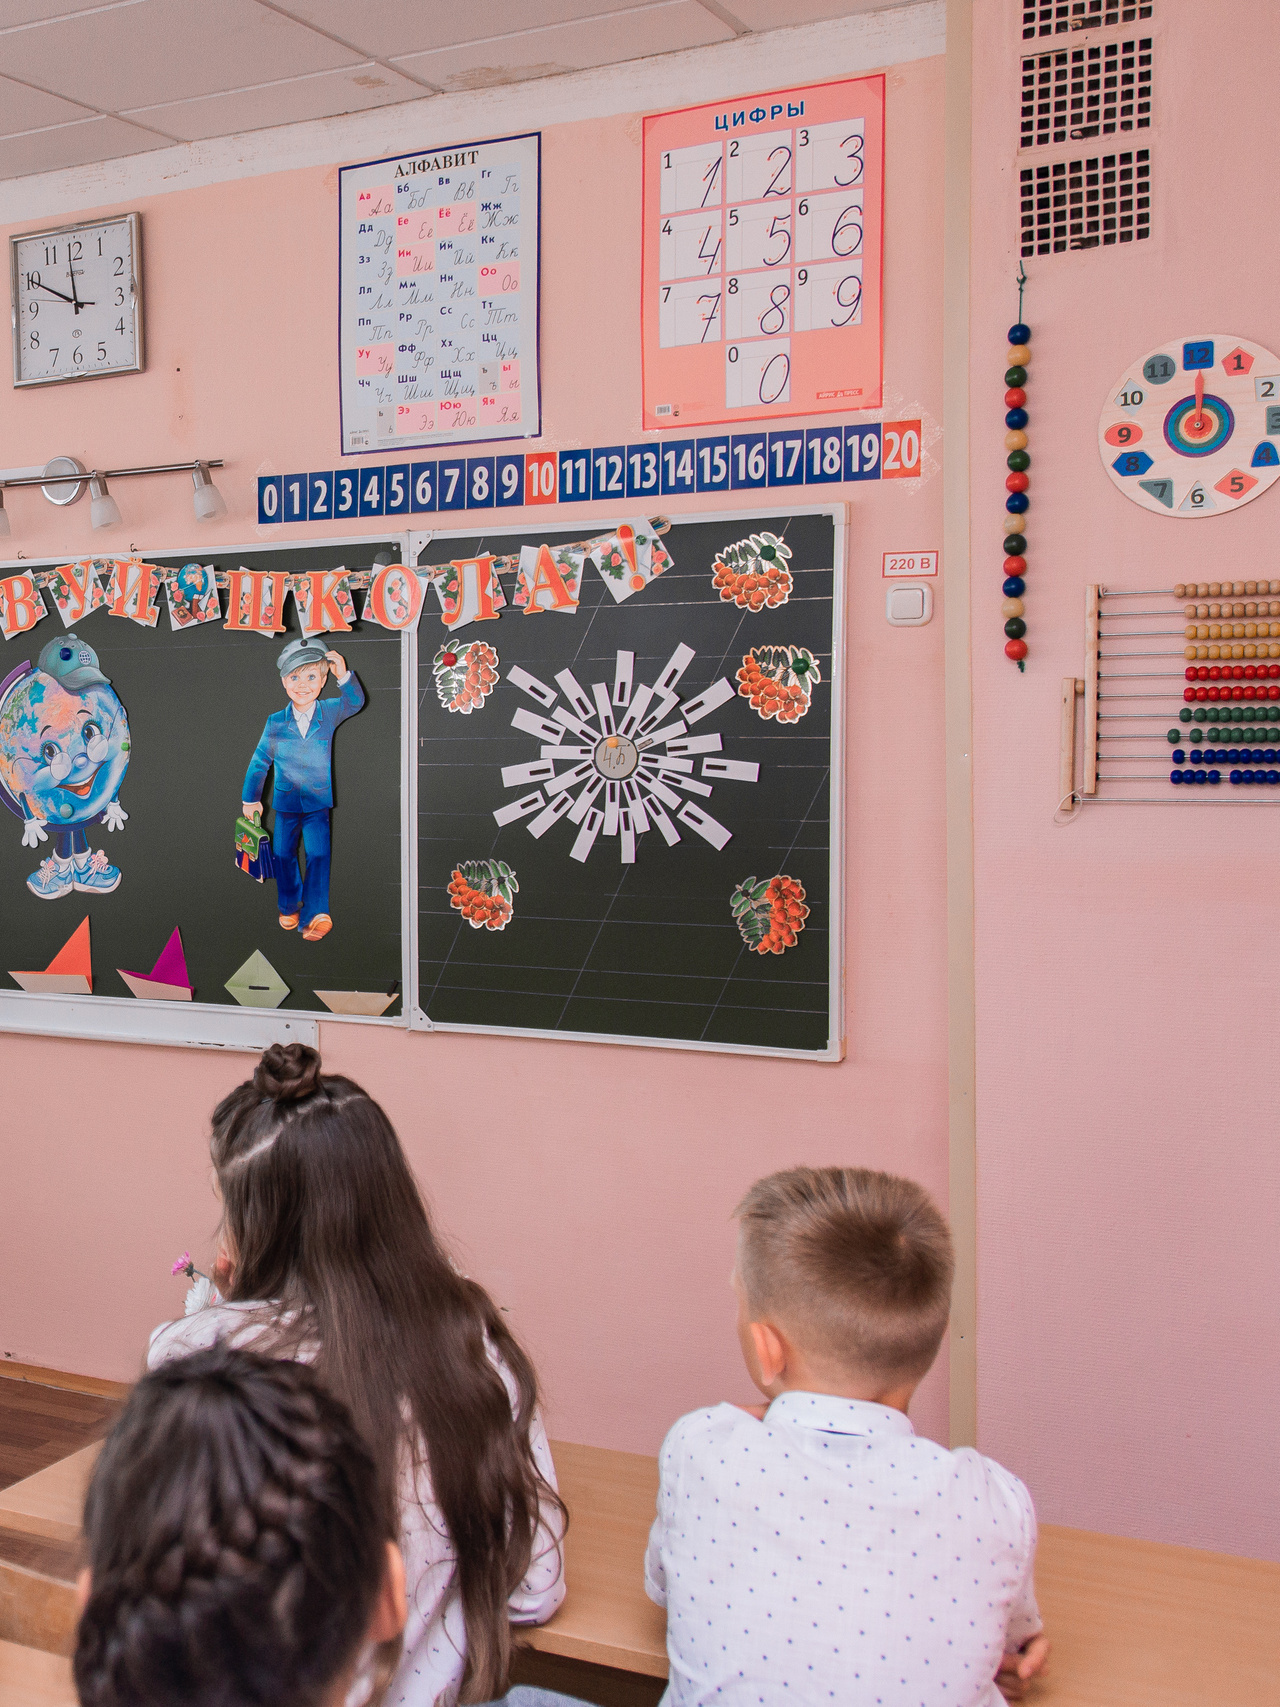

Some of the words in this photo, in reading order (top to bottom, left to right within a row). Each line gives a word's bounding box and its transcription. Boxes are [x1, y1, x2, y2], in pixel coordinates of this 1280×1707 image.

[714, 101, 805, 131] ЦИФРЫ
[394, 151, 479, 178] АЛФАВИТ
[800, 130, 809, 146] 3
[834, 135, 864, 186] 3
[730, 142, 739, 157] 2
[763, 146, 791, 197] 2
[664, 154, 672, 168] 1
[701, 156, 722, 208] 1
[730, 210, 738, 225] 5
[763, 214, 791, 265] 5
[799, 200, 808, 215] 6
[832, 205, 863, 256] 6
[44, 245, 57, 266] 11
[67, 241, 83, 261] 12
[97, 237, 102, 256] 1
[662, 220, 672, 235] 4
[698, 226, 722, 274] 4
[113, 257, 124, 276] 2
[26, 271, 41, 290] 10
[115, 287, 124, 306] 3
[798, 270, 808, 285] 9
[831, 276, 861, 326] 9
[29, 302, 39, 320] 9
[662, 288, 671, 302] 7
[697, 293, 721, 342] 7
[729, 279, 738, 294] 8
[760, 285, 790, 334] 8
[115, 317, 125, 335] 4
[30, 331, 40, 349] 8
[50, 348, 59, 367] 7
[73, 345, 83, 364] 6
[97, 342, 106, 360] 5
[1186, 348, 1211, 364] 12
[1148, 362, 1170, 378] 11
[1233, 355, 1244, 371] 1
[729, 347, 738, 362] 0
[760, 354, 790, 404] 0
[1121, 391, 1143, 406] 10
[1261, 382, 1274, 397] 2
[1118, 427, 1131, 443] 9
[1125, 457, 1139, 472] 8
[1258, 448, 1272, 463] 4
[263, 484, 277, 516] 0
[289, 482, 300, 514] 1
[313, 480, 327, 513] 2
[339, 478, 352, 511] 3
[364, 476, 379, 508] 4
[390, 473, 404, 507] 5
[416, 470, 432, 504] 6
[445, 469, 460, 502] 7
[472, 466, 489, 500] 8
[502, 464, 518, 498] 9
[528, 461, 554, 496] 10
[562, 458, 586, 494] 11
[595, 455, 622, 491] 12
[629, 452, 657, 489] 13
[664, 449, 693, 486] 14
[699, 446, 727, 483] 15
[734, 443, 765, 480] 16
[771, 440, 802, 478] 17
[808, 437, 841, 475] 18
[847, 434, 879, 472] 19
[884, 430, 919, 470] 20
[1154, 483, 1167, 498] 7
[1230, 477, 1244, 492] 5
[1191, 489, 1204, 508] 6
[890, 559, 914, 570] 220
[921, 558, 930, 569] В
